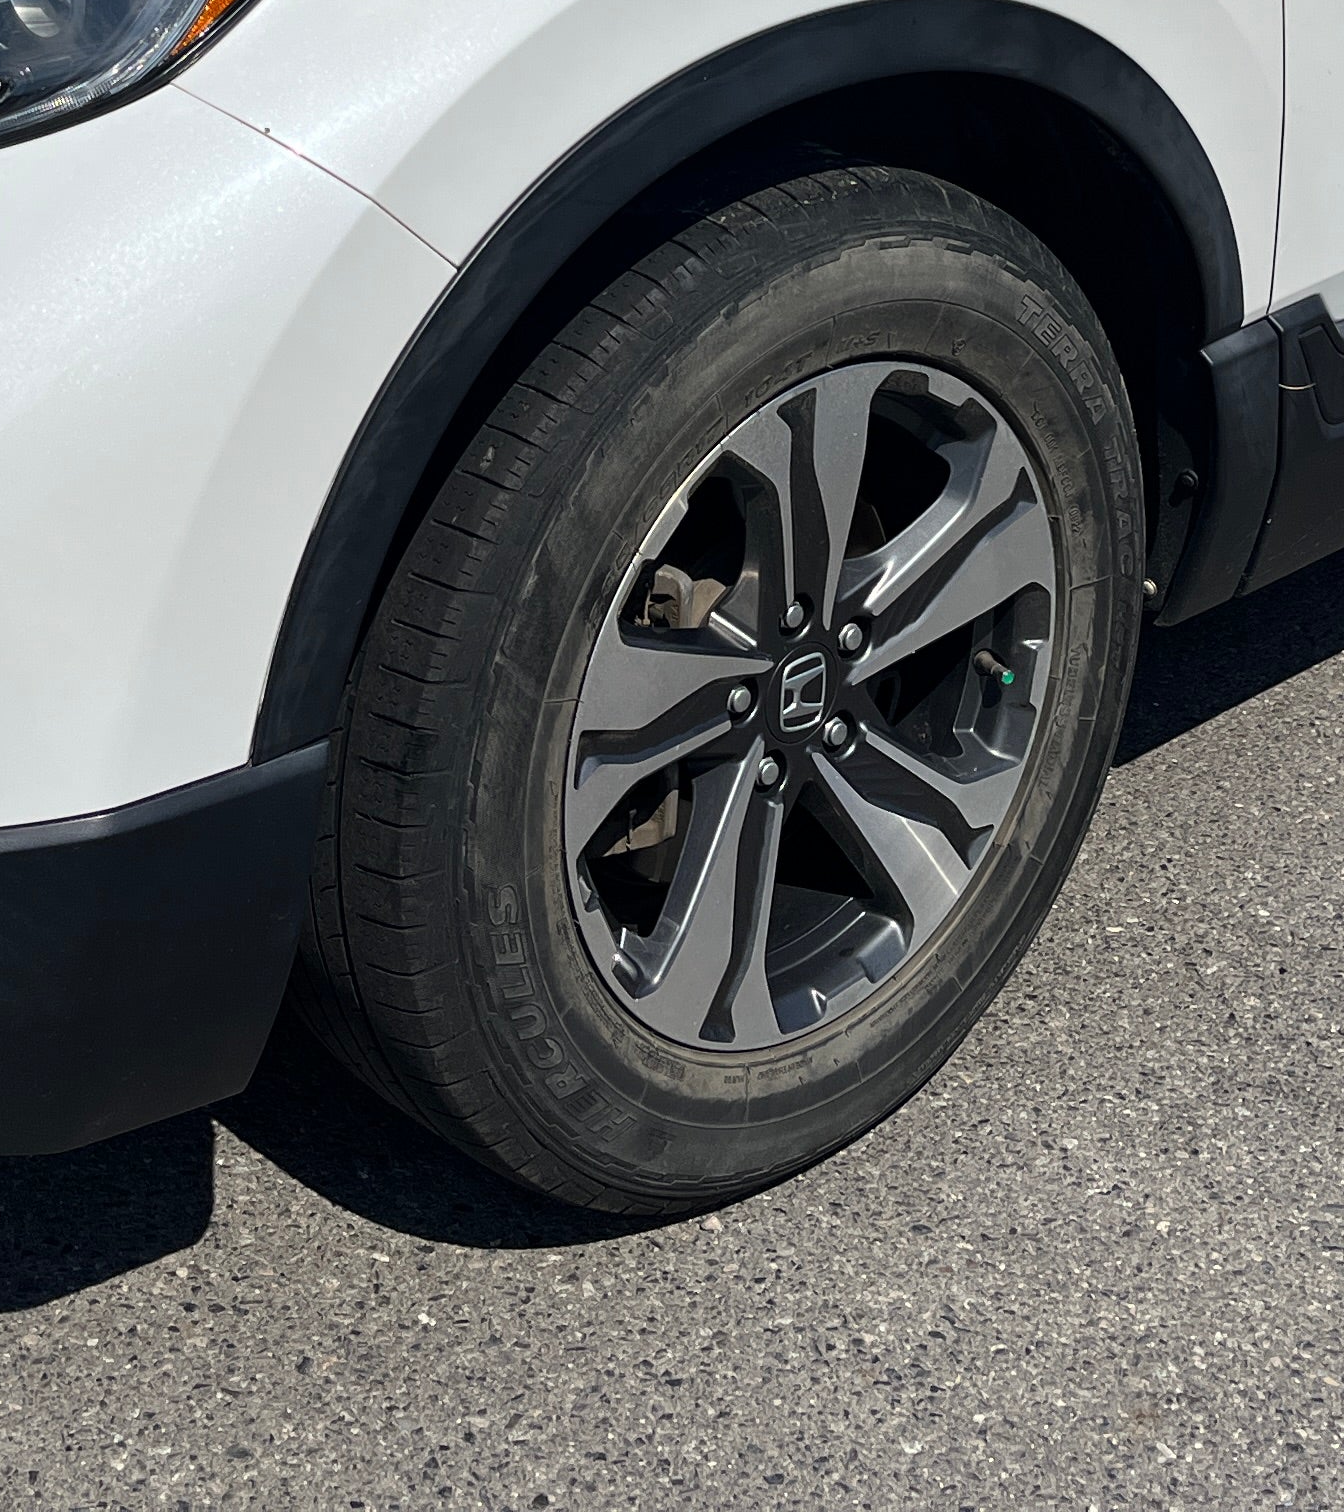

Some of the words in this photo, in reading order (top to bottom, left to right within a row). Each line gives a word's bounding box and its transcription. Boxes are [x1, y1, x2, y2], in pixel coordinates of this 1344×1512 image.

[1017, 294, 1108, 426] TERRA
[1103, 436, 1135, 578] TRAC
[488, 885, 637, 1143] HERCULES
